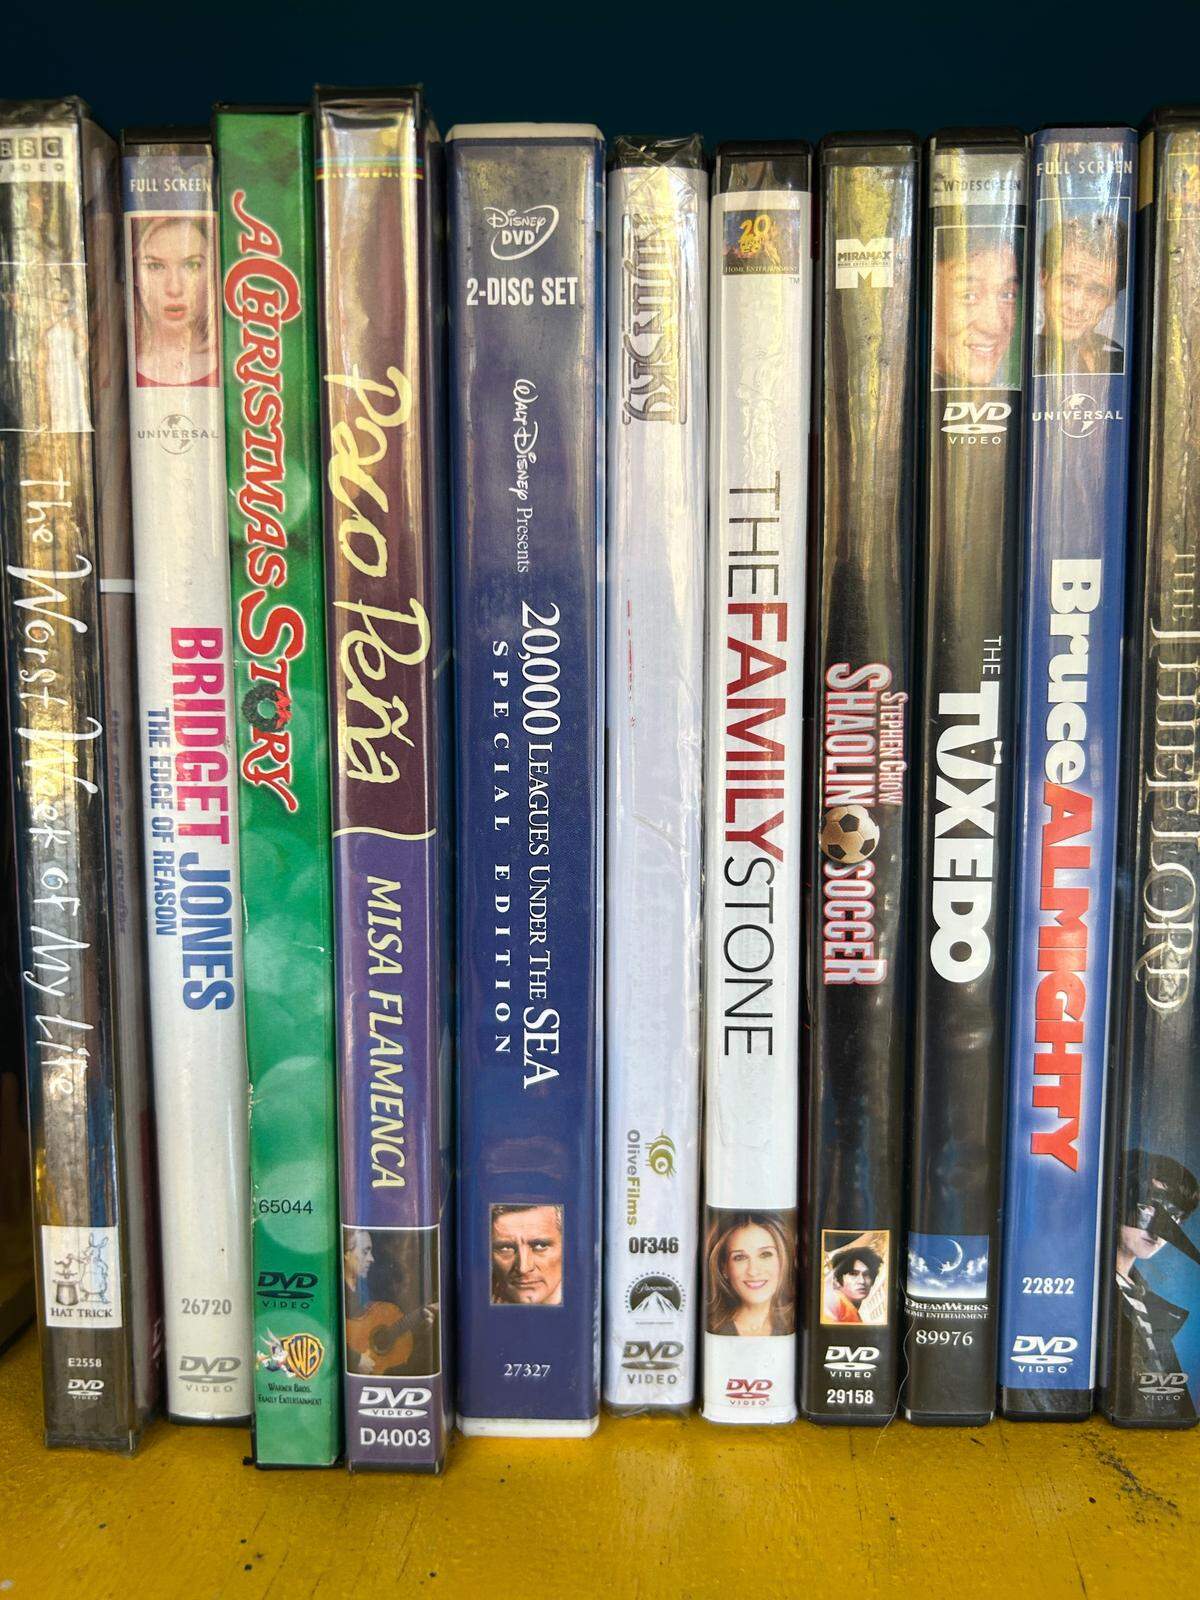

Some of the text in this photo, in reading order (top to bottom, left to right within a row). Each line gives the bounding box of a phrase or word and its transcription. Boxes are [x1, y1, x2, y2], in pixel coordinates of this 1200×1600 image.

[1036, 161, 1070, 176] FULL
[130, 177, 213, 192] FULL SCREEN
[502, 230, 535, 246] DVD
[466, 276, 579, 306] 2-DISC SET
[224, 256, 303, 588] CHRISTMAS
[943, 402, 1012, 424] DVD
[1032, 410, 1123, 422] UNIVERSAL
[137, 428, 219, 439] UNIVERSAL
[949, 437, 1002, 445] VIDEO
[20, 468, 72, 543] The
[516, 507, 533, 573] Presents
[7, 554, 93, 709] Worst
[983, 635, 1002, 675] THE
[238, 590, 307, 813] STORY
[725, 602, 788, 863] FAMILY
[825, 662, 893, 808] SHAOLIN
[879, 691, 909, 806] STEPHEN CHOW
[147, 706, 177, 936] THE EDGE OF REASON
[170, 627, 236, 1011] BRIDGET JONES
[930, 681, 1002, 984] TUXEDO
[492, 640, 511, 1053] SPECIAL EDITION
[517, 600, 561, 1090] 20,000 LEAGUES UNDER THE SEA
[1031, 558, 1102, 1172] Bruce ALMIGHTY
[823, 859, 888, 985] SOCCER
[23, 925, 91, 997] My
[723, 856, 775, 1056] STONE
[367, 875, 406, 1189] MISA FLAMENCA
[626, 1129, 641, 1226] OliveFilms
[258, 1199, 314, 1214] 65044
[257, 1271, 319, 1290] DVD
[1022, 1277, 1075, 1294] 22822
[50, 1308, 113, 1318] HAT TRICK
[181, 1298, 232, 1315] 26720
[262, 1301, 311, 1309] VIDEO
[926, 1311, 988, 1320] ENTERTAINMENT
[915, 1329, 974, 1346] 89976
[1013, 1335, 1078, 1354] DVD
[622, 1340, 685, 1359] DVD
[825, 1346, 880, 1362] DVD
[67, 1357, 103, 1368] E2558
[179, 1355, 242, 1375] DVD
[504, 1363, 551, 1377] 27327
[1018, 1365, 1068, 1374] VIDEO
[67, 1378, 105, 1391] DVD
[626, 1374, 678, 1384] VIDEO
[725, 1378, 773, 1393] DVD
[1139, 1372, 1189, 1386] DVD
[360, 1386, 432, 1408] DVD
[826, 1389, 874, 1405] 29158
[360, 1427, 431, 1446] D4003
